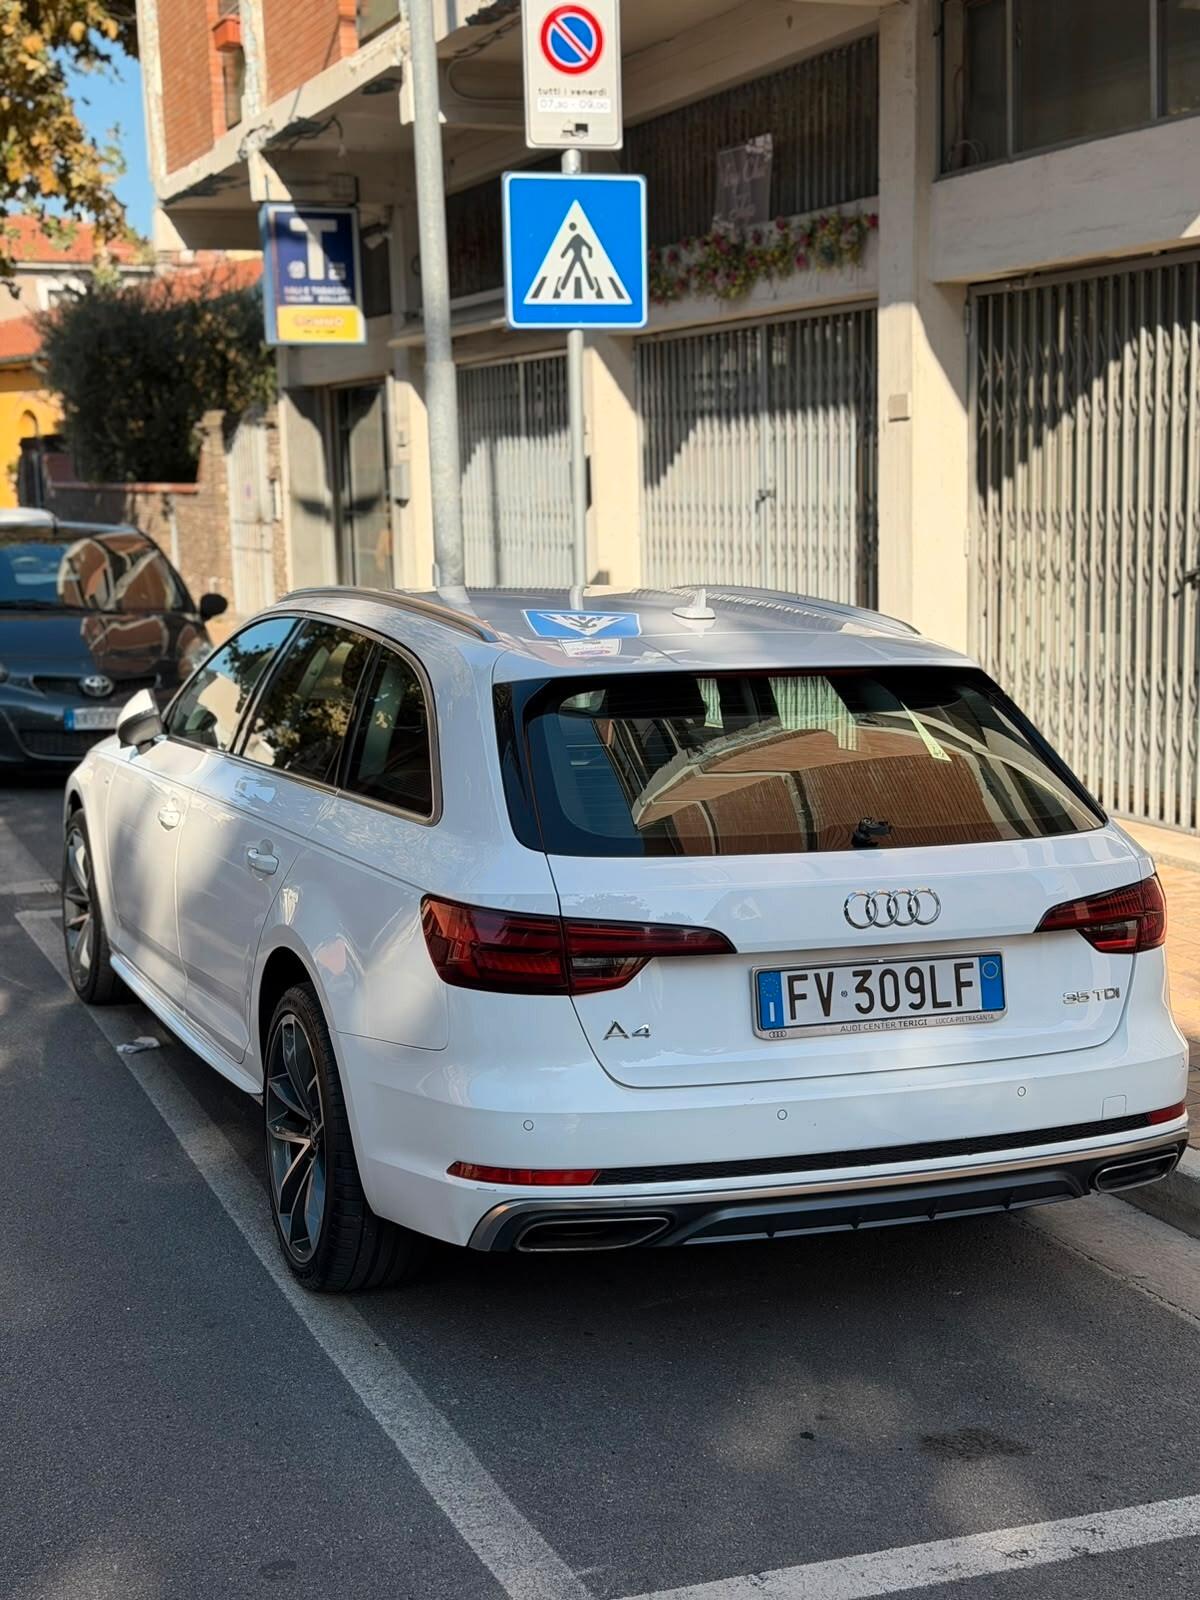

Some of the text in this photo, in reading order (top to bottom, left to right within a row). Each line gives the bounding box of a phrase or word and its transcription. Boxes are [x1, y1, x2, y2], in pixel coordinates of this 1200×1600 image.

[538, 87, 560, 96] tutti
[290, 217, 338, 280] T
[602, 1021, 651, 1040] A4
[839, 1018, 928, 1032] AUDI CENTER TERIGI
